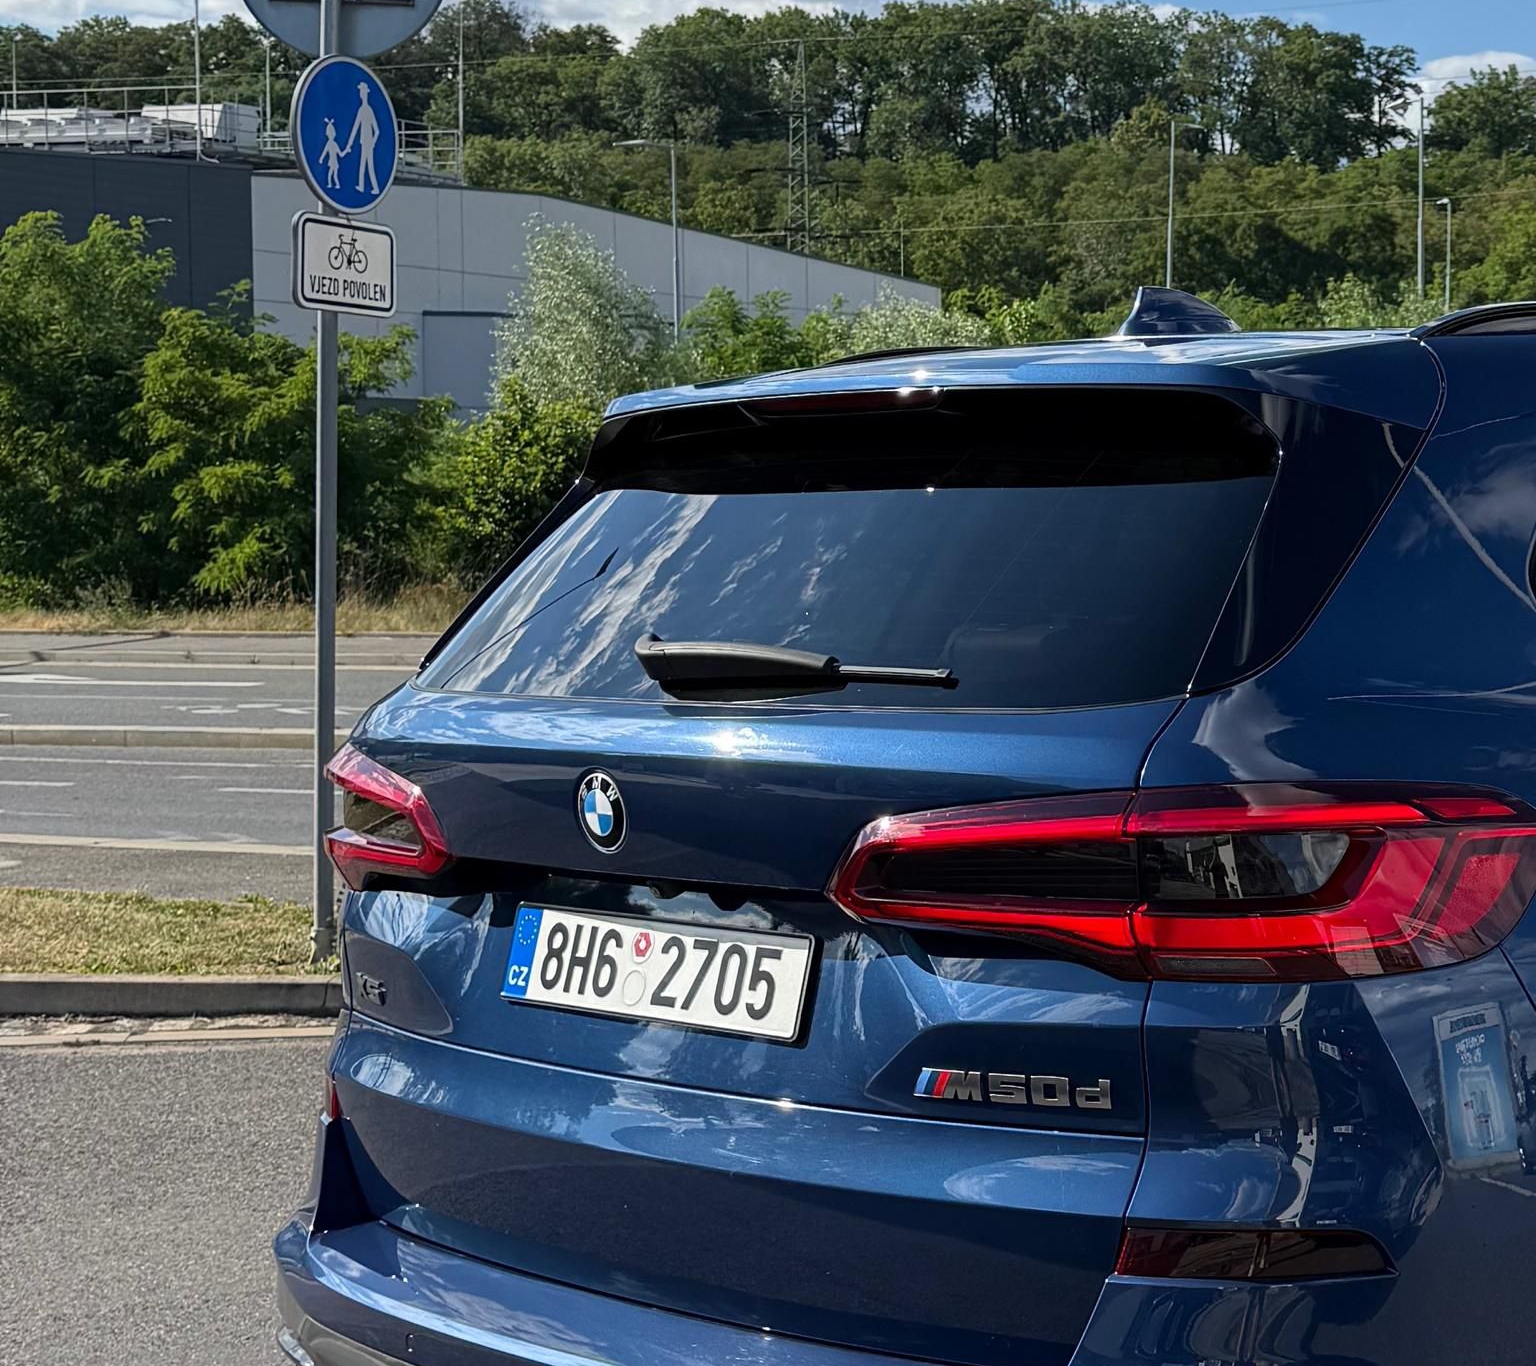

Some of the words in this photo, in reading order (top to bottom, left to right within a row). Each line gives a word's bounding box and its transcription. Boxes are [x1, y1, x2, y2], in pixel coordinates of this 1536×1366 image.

[309, 274, 340, 296] VJEZD
[342, 278, 387, 303] POVOLEN
[508, 965, 529, 986] CZ
[539, 921, 624, 998] 8H6
[649, 935, 784, 1021] 2705
[914, 1066, 1112, 1110] M50d
